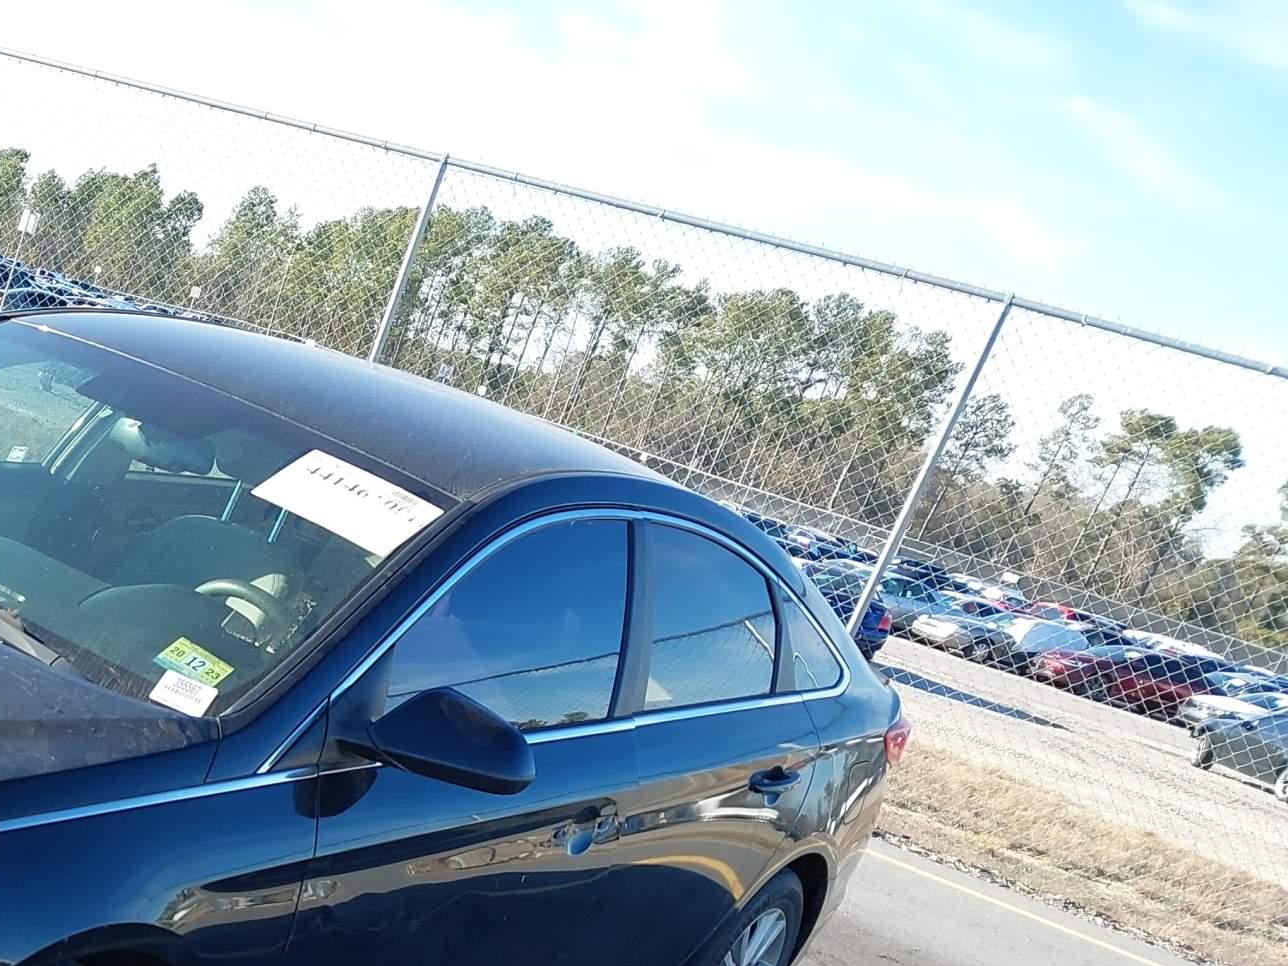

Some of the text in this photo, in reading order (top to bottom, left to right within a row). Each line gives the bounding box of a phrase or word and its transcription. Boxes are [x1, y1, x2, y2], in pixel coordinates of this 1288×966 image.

[170, 647, 221, 680] 20 12 23
